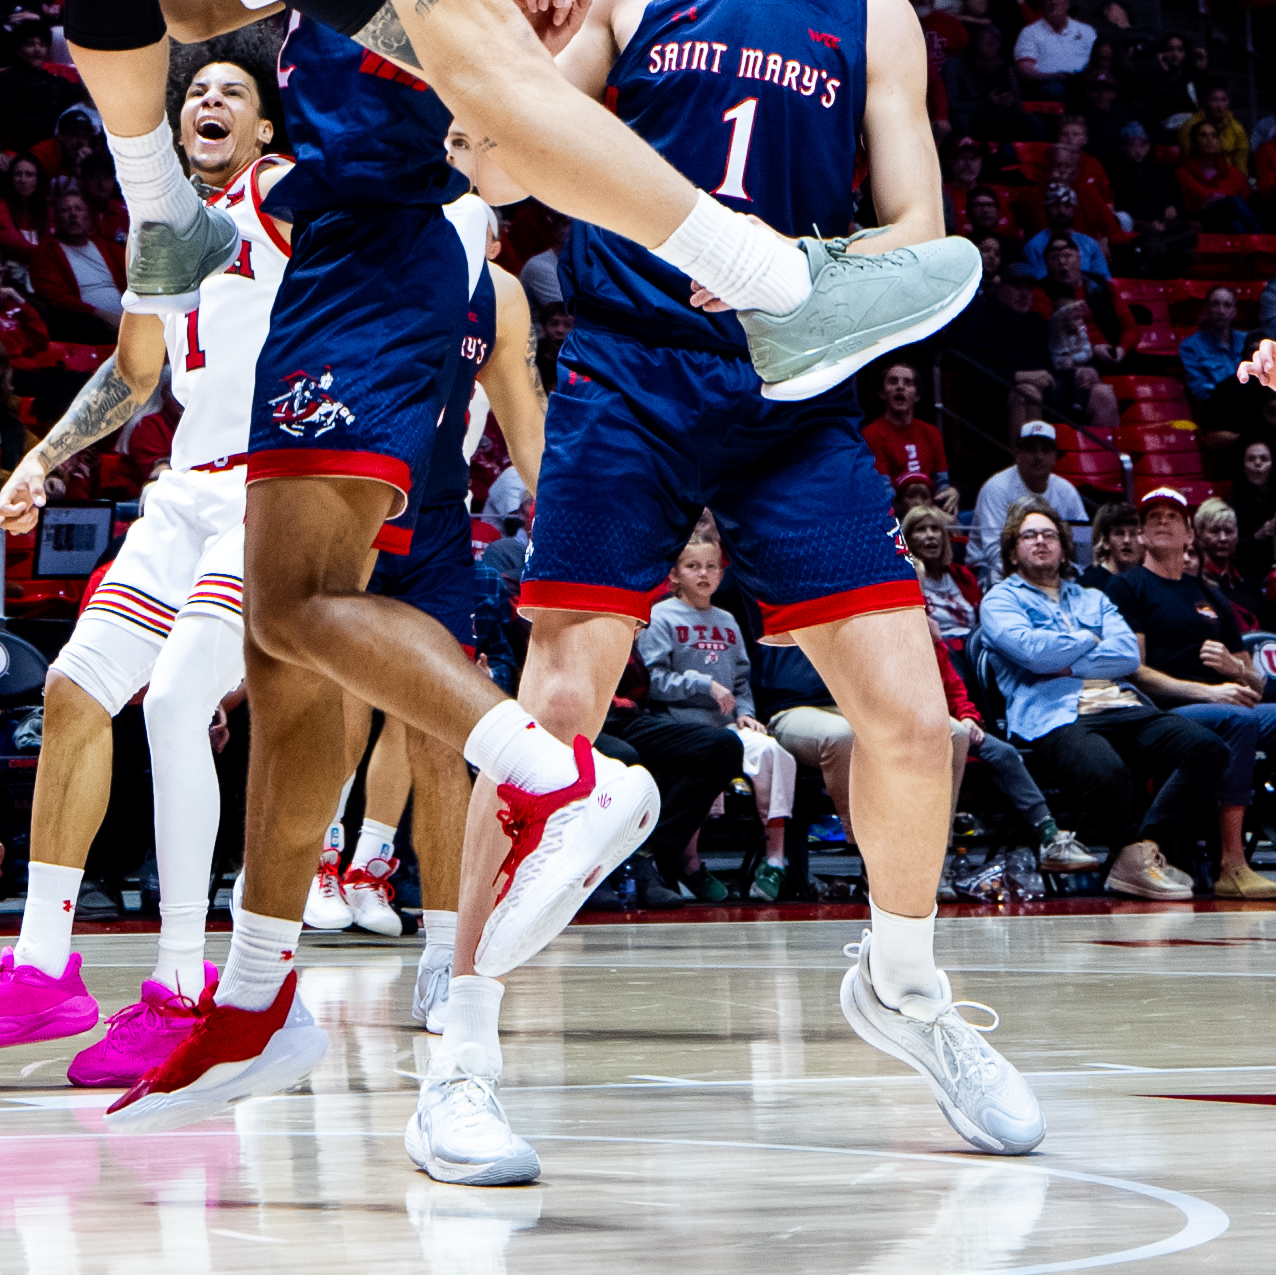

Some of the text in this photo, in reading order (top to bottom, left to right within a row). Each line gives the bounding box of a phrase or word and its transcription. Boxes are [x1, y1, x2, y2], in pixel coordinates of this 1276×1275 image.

[648, 41, 841, 108] SAINT MARY'S
[710, 96, 759, 201] 1
